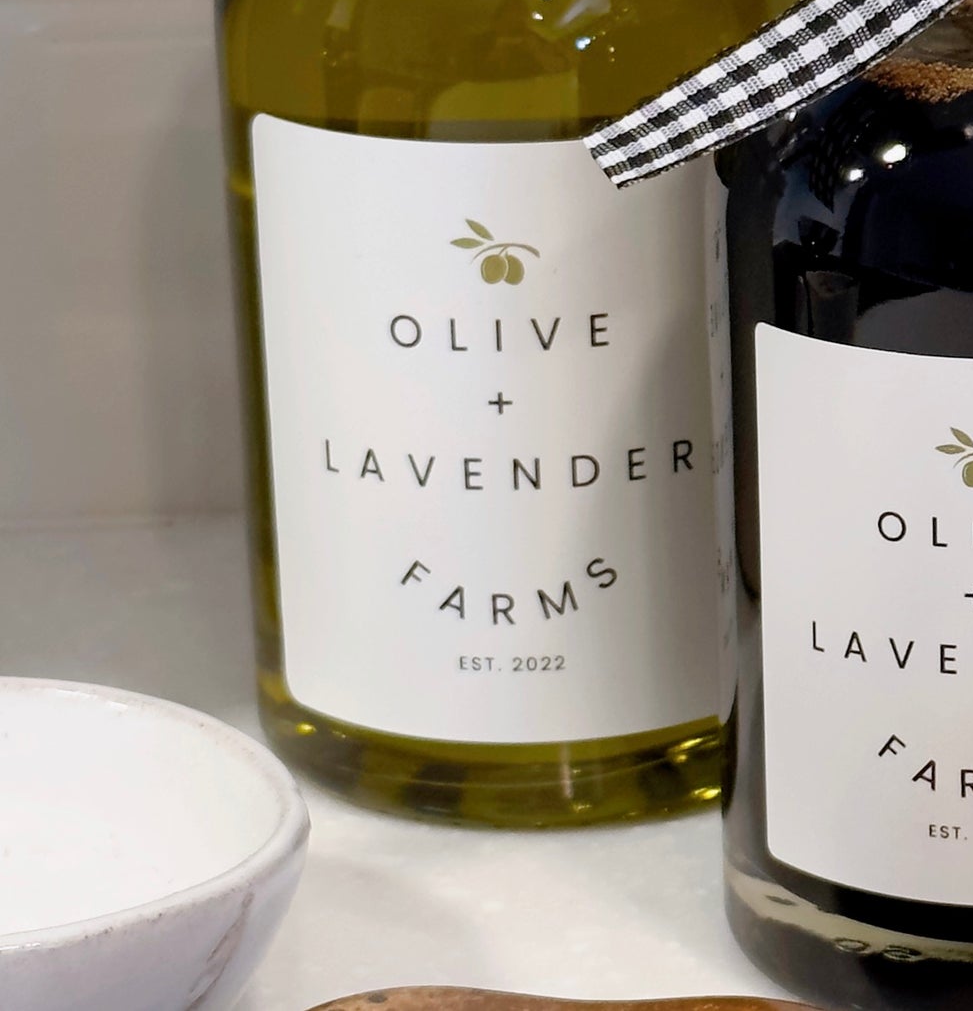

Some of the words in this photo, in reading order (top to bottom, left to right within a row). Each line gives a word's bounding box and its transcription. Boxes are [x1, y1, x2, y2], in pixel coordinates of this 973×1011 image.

[389, 312, 612, 353] OLIVE
[487, 391, 513, 415] +
[324, 438, 695, 491] LAVENDER
[400, 556, 618, 625] FARMS
[458, 656, 502, 672] EST.
[512, 655, 566, 672] 2022
[928, 823, 969, 841] EST.
